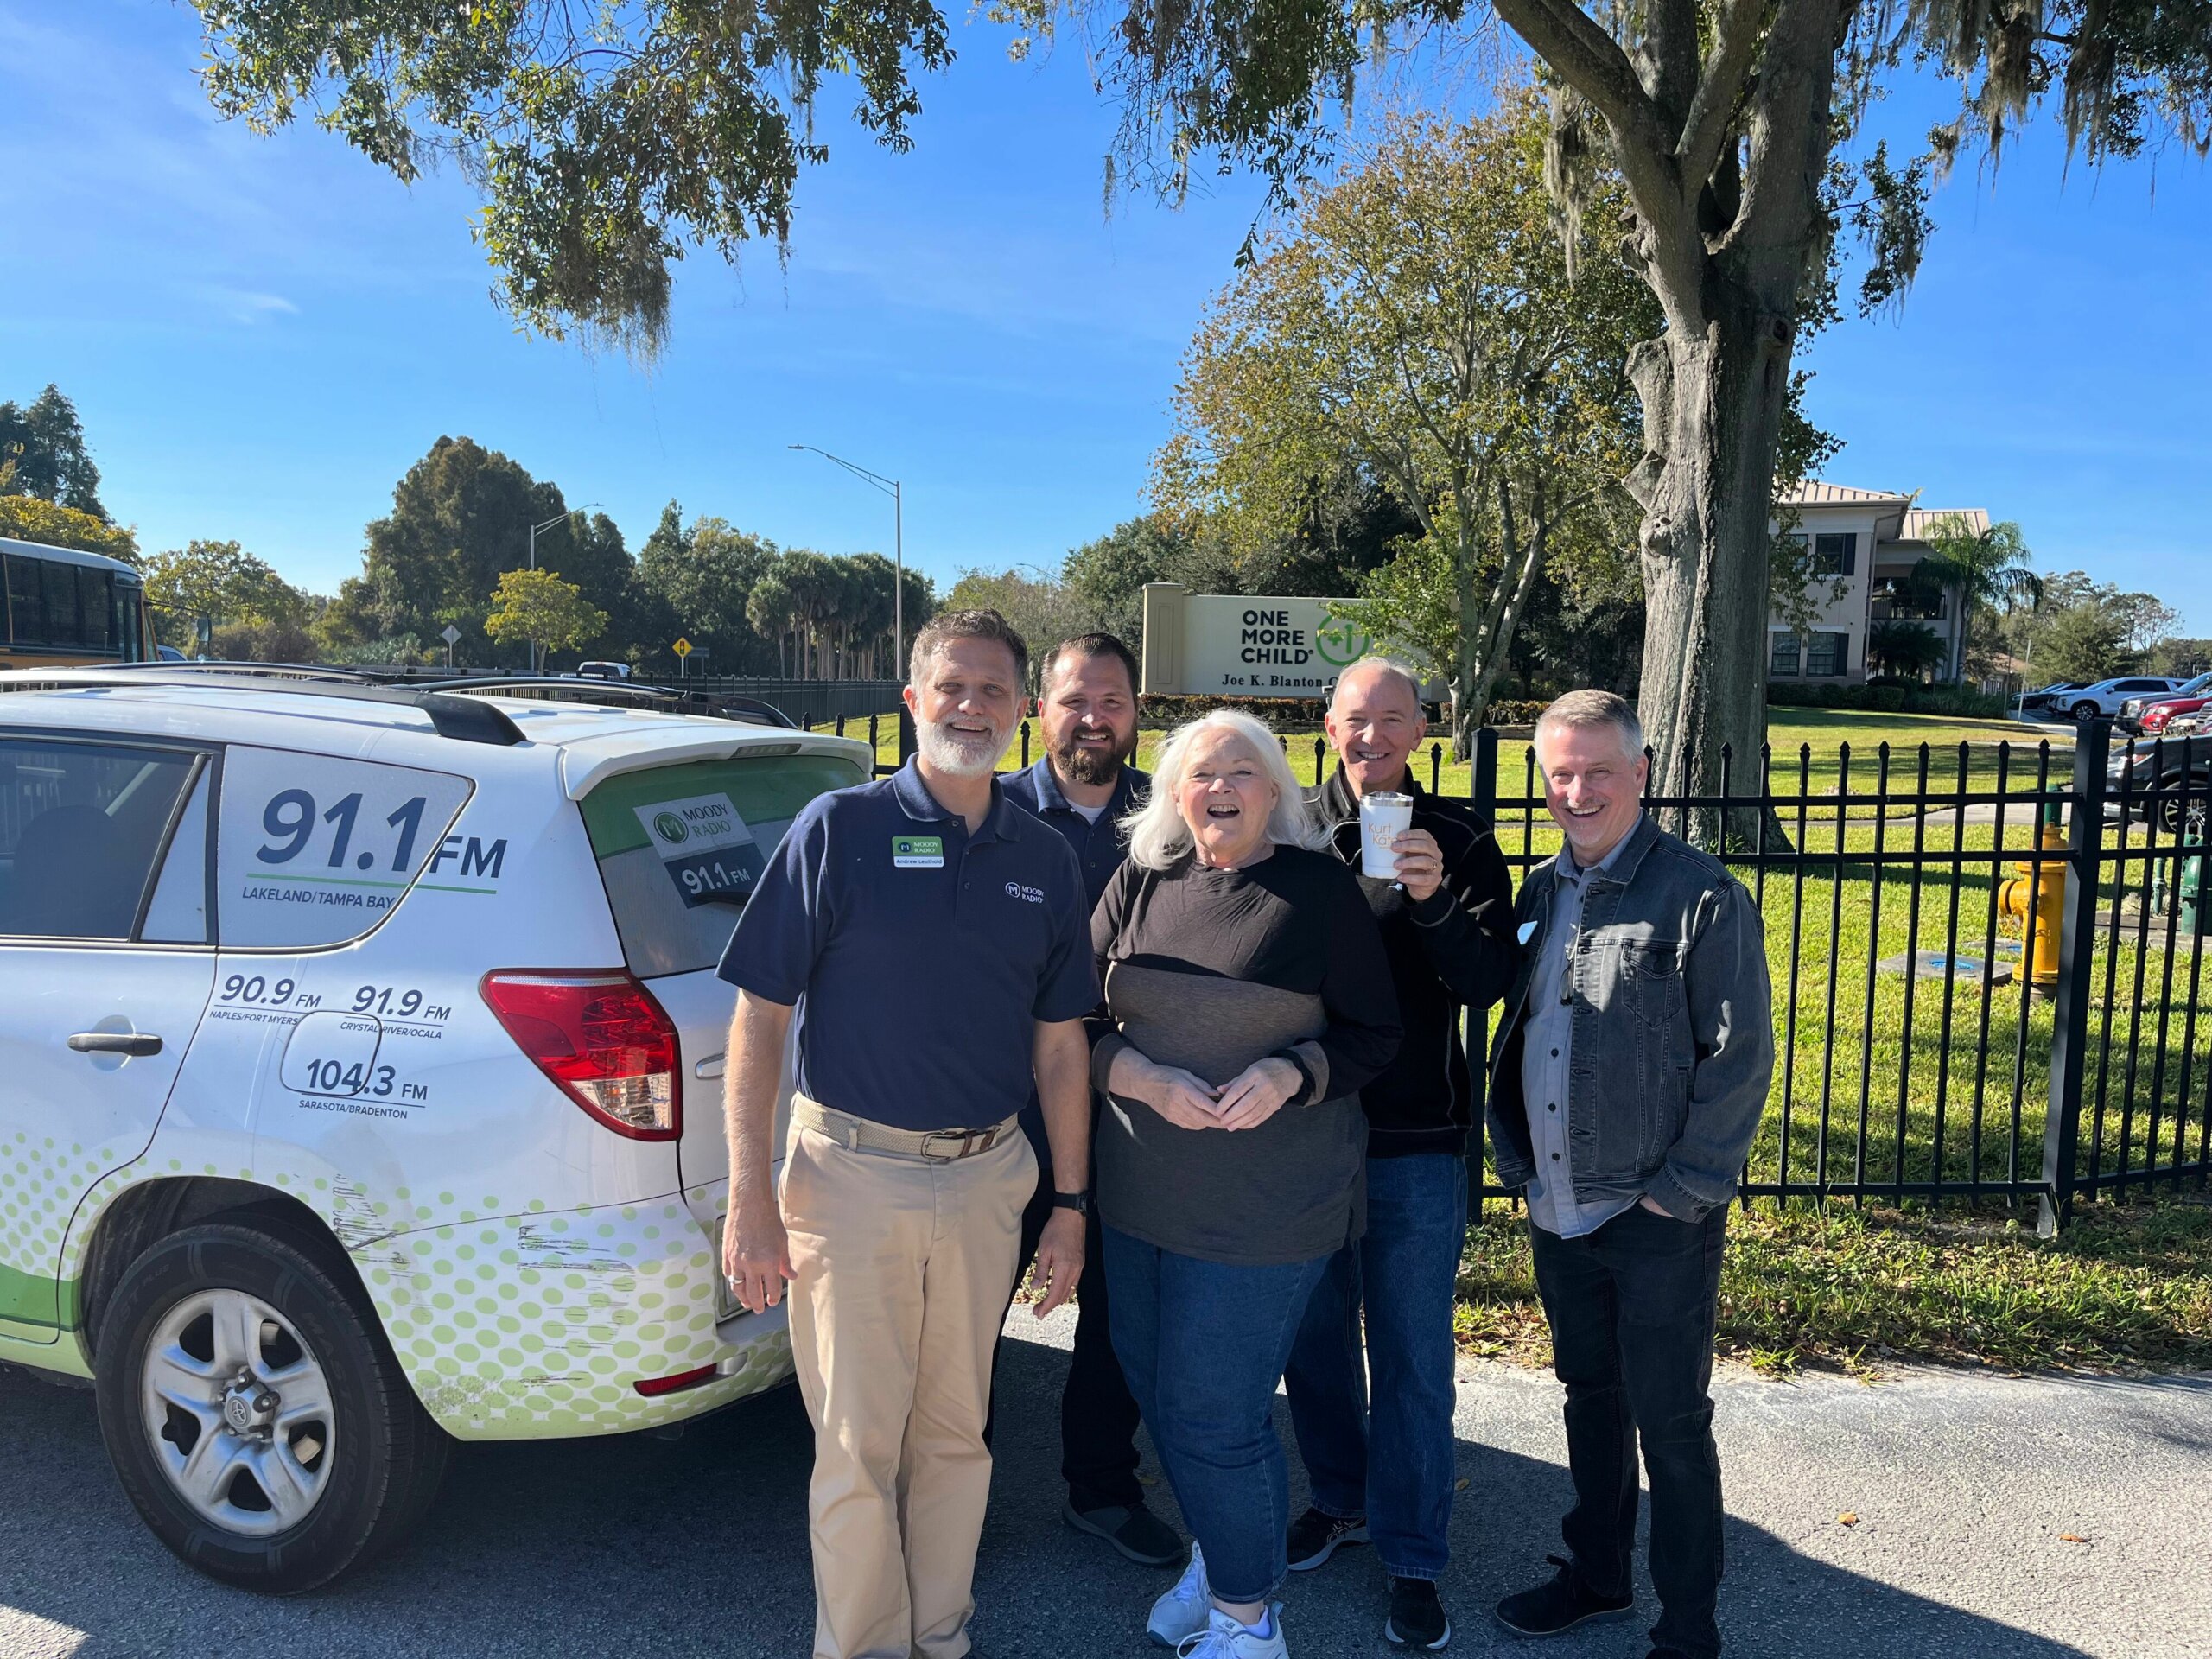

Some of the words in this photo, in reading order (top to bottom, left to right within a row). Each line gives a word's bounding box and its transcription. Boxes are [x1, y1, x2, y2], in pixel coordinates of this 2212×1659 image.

[1242, 609, 1289, 626] ONE
[1241, 629, 1305, 646] MORE
[1222, 674, 1245, 687] Joe
[1250, 675, 1265, 687] K.
[1269, 674, 1324, 688] Blanton
[683, 804, 728, 821] MOODY
[255, 788, 427, 872] 91.1
[429, 835, 508, 879] FM
[692, 820, 731, 837] RADIO
[681, 861, 732, 895] 91.1
[729, 868, 751, 884] FM
[241, 887, 364, 907] LAKELAND/TAMPA
[365, 894, 397, 909] BAY
[1021, 886, 1044, 897] MOODY
[1021, 893, 1044, 904] RADIO
[220, 974, 296, 1005] 90.9
[295, 994, 322, 1008] FM
[351, 985, 423, 1017] 91.9
[423, 1005, 452, 1020] FM
[208, 1010, 268, 1023] NAPLES/FORT
[267, 1015, 299, 1026] MYERS
[340, 1021, 379, 1033] CRYSTAL
[380, 1026, 442, 1040] RIVER/OCALA
[306, 1058, 397, 1096] 104.3
[400, 1084, 429, 1101] FM
[298, 1099, 409, 1120] SARASOTA/BRADENTON
